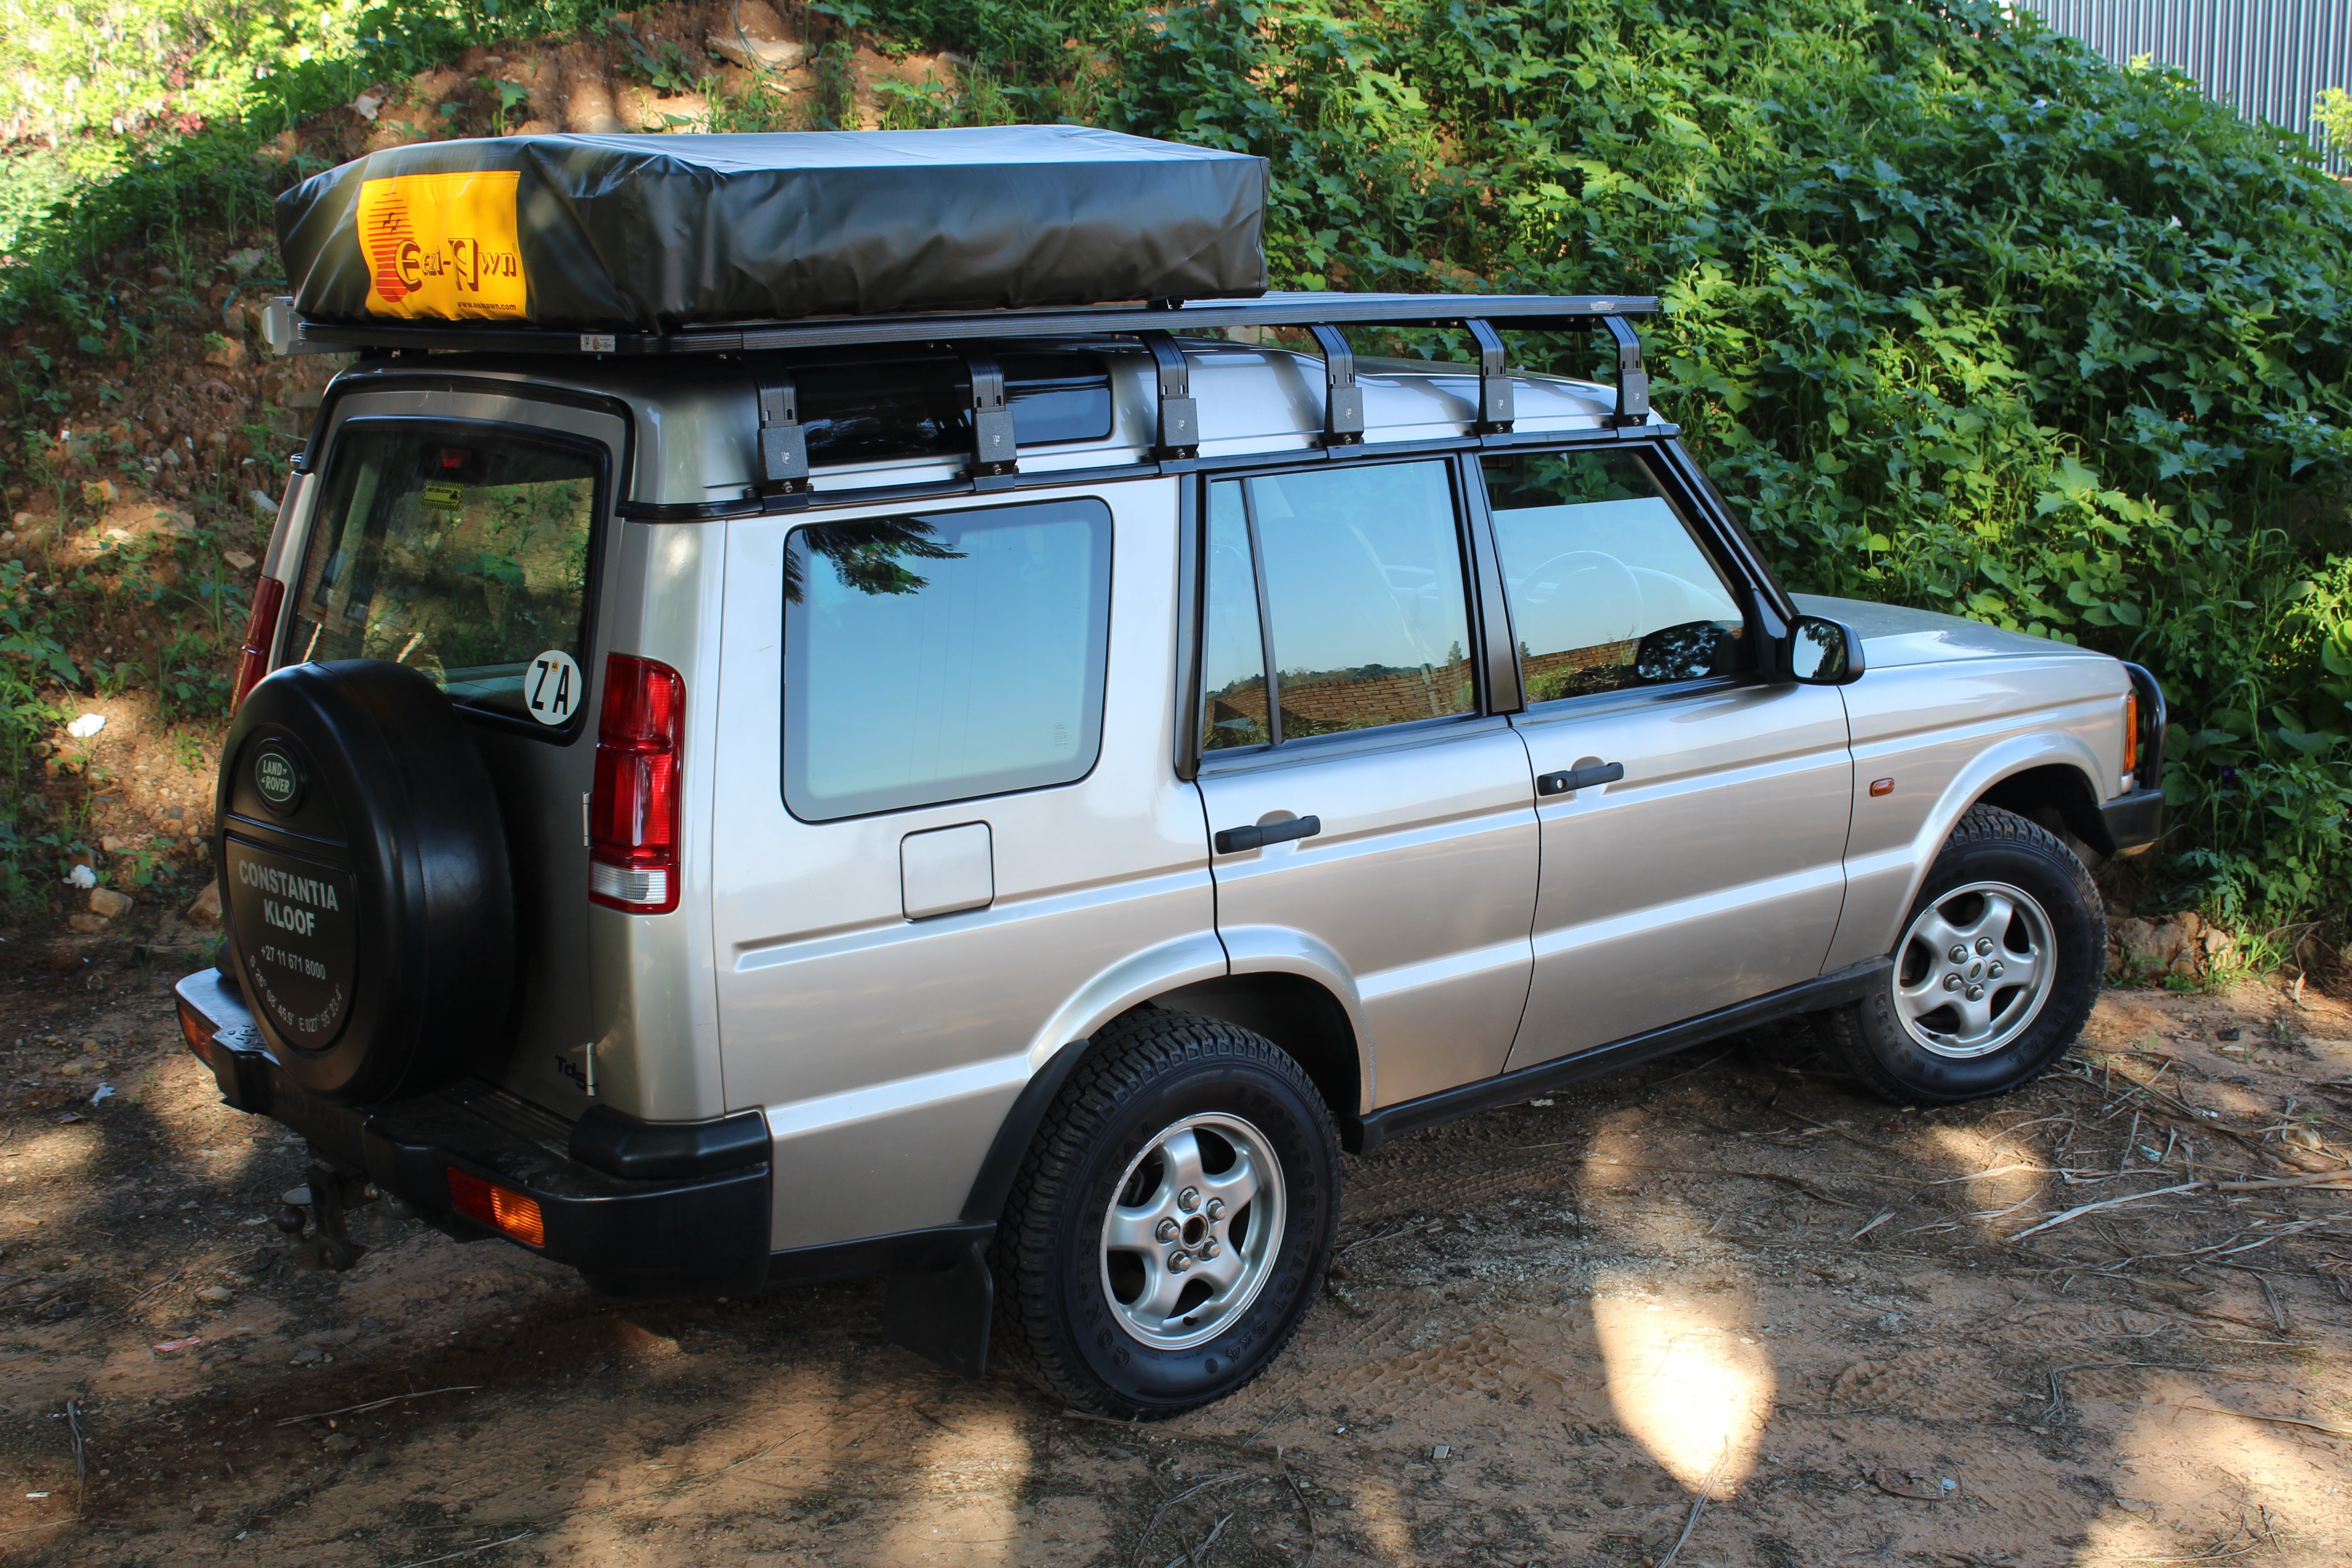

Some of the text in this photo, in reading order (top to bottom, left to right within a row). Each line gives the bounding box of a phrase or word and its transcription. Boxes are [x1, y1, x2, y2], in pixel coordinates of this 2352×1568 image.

[531, 660, 570, 715] ZA
[263, 760, 283, 776] LAND
[265, 776, 290, 793] ROVER
[239, 859, 339, 911] CONSTANTIA
[264, 899, 315, 937] KLOOF
[261, 944, 326, 980] +27 11 671 8000
[299, 1017, 306, 1032] E
[1253, 1092, 1317, 1316] WORLDCONTACT
[1080, 1120, 1155, 1368] CONTINENTAL
